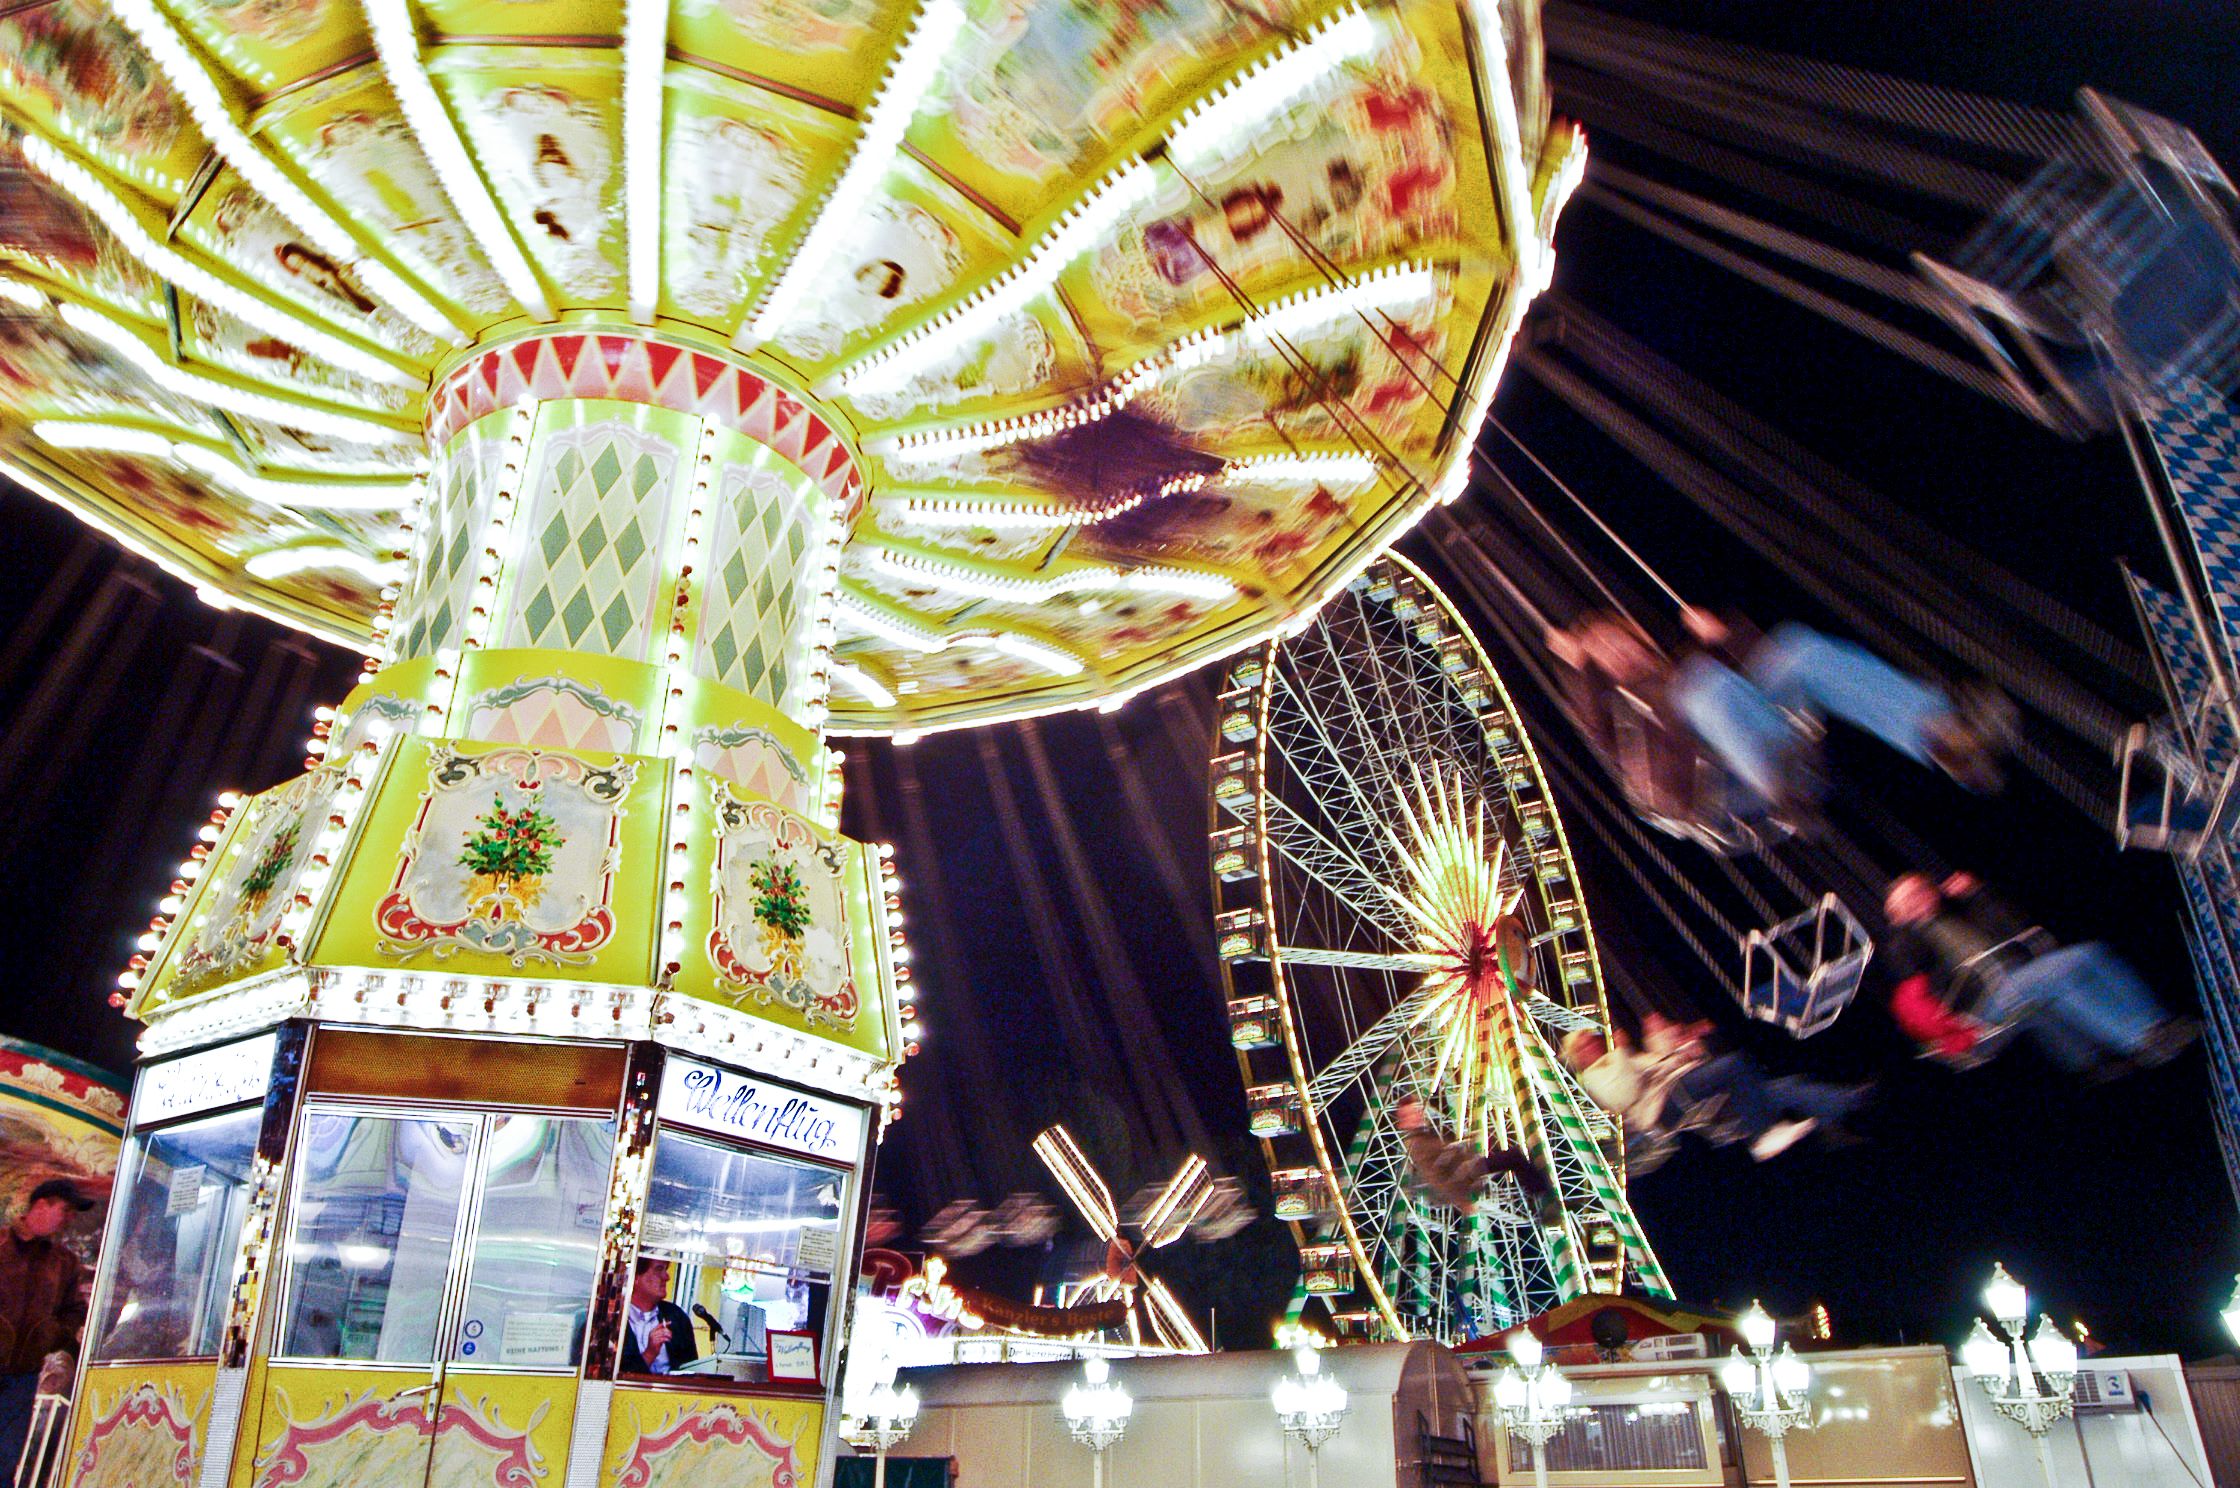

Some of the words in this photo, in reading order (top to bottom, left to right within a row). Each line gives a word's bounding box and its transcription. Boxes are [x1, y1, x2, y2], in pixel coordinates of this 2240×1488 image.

[684, 1069, 837, 1152] Wellenflug
[982, 1299, 1060, 1326] Kanzler's
[1067, 1307, 1115, 1325] Beste
